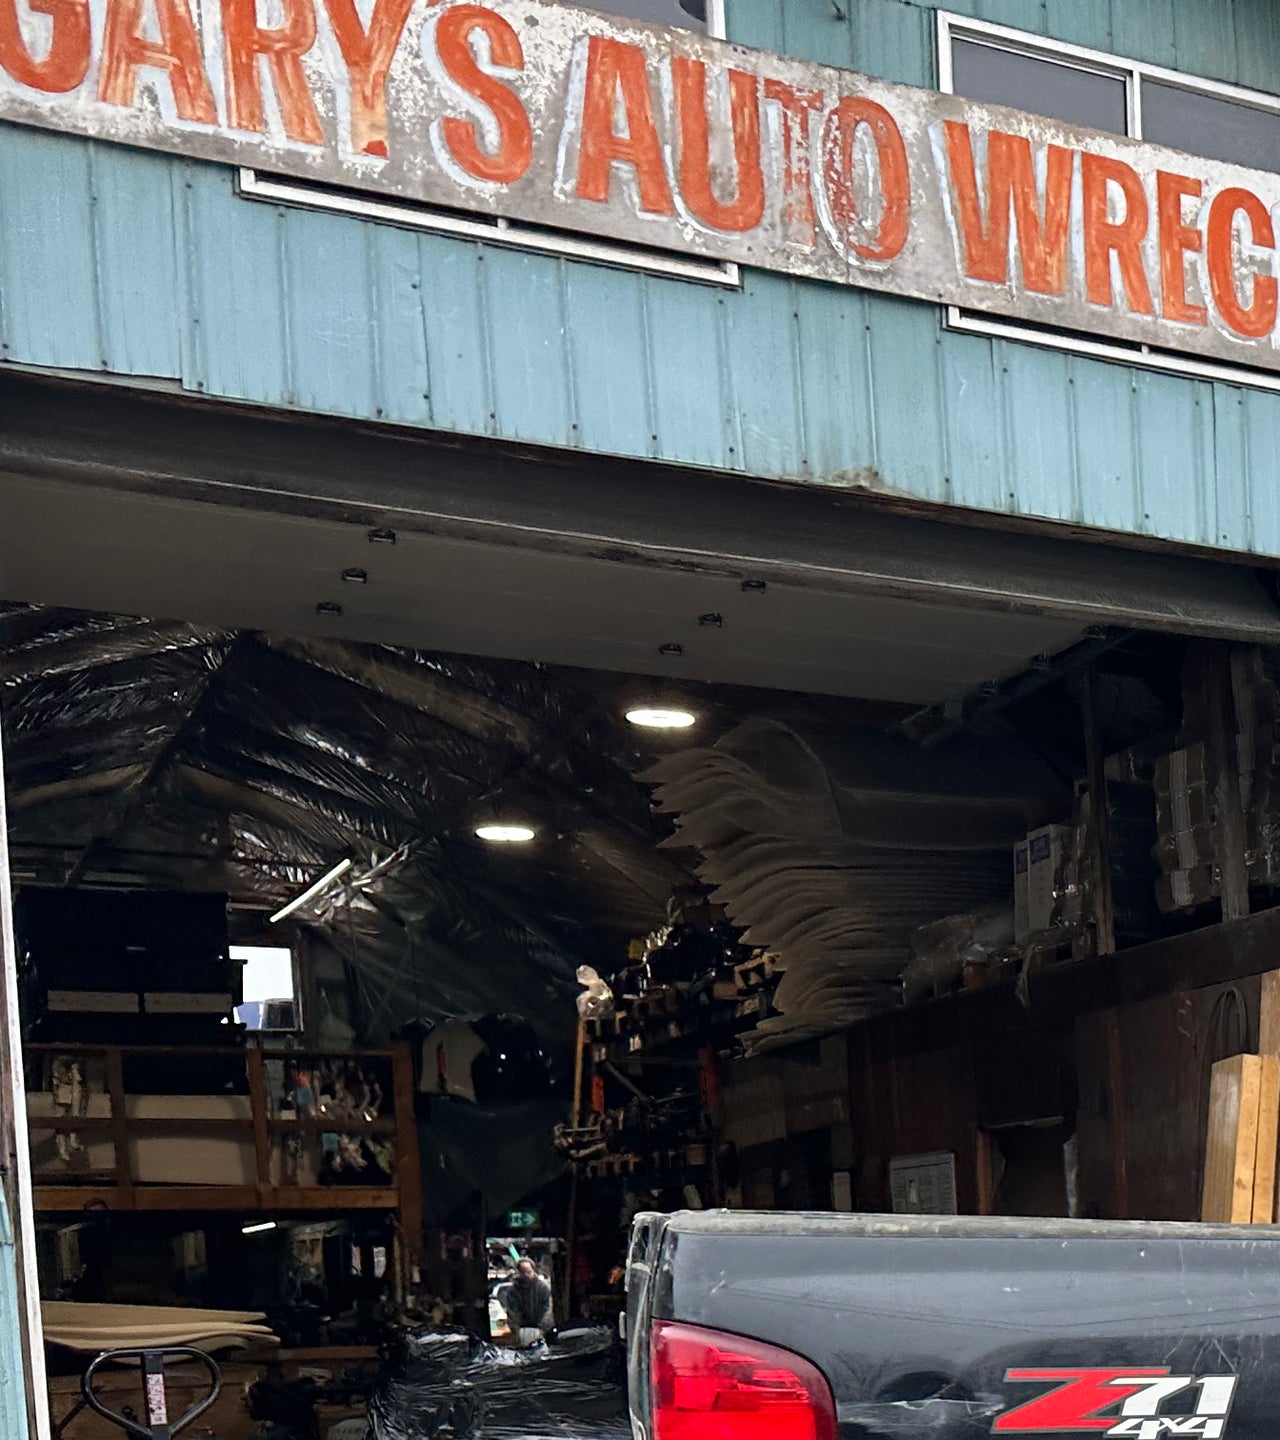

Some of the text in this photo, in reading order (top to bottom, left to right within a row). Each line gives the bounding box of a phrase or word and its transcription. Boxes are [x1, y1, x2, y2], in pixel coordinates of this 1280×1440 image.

[0, 0, 534, 186] GARYS
[555, 36, 911, 268] AUTO
[992, 1366, 1239, 1433] Z71
